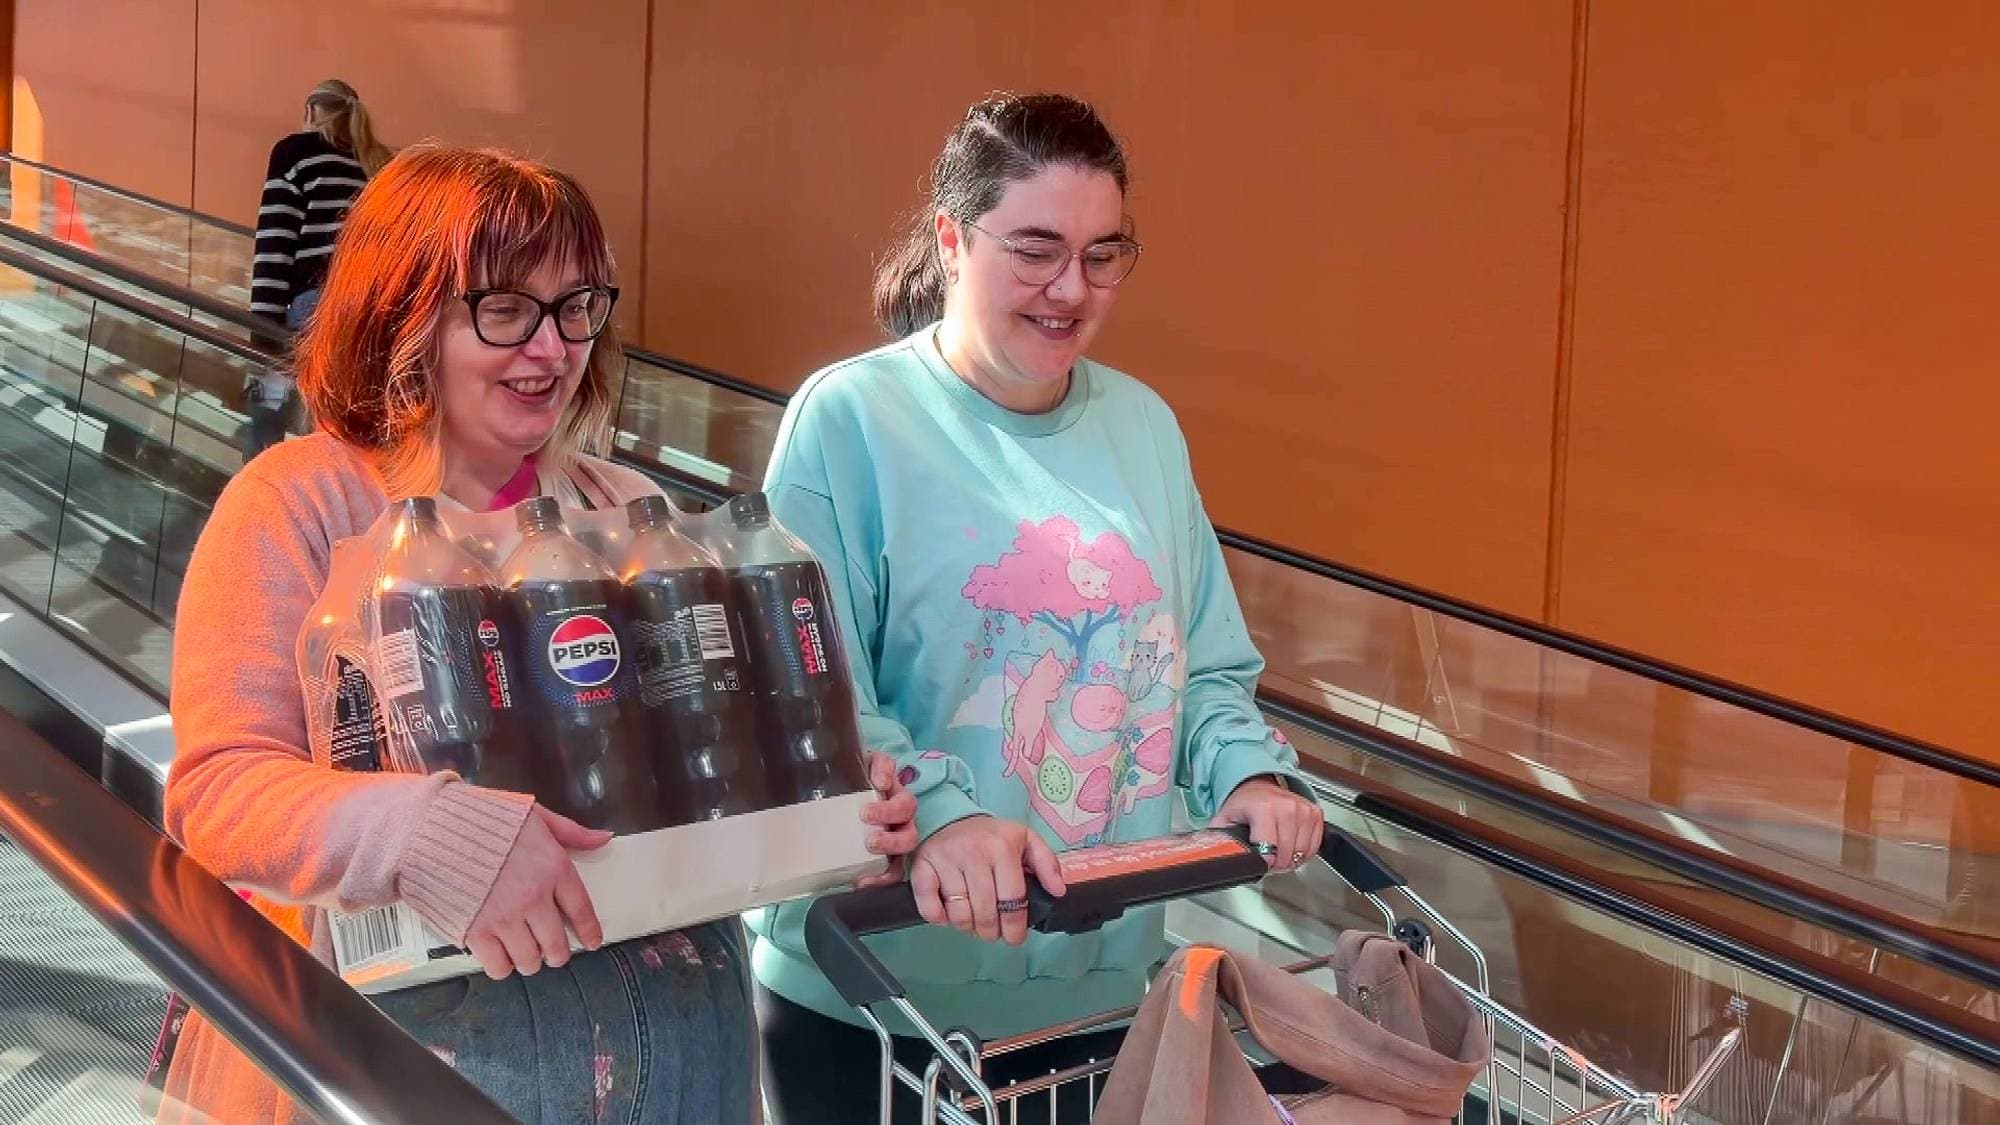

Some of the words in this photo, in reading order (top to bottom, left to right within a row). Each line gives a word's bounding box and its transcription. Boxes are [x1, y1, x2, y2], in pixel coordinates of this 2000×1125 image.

[552, 640, 617, 664] PEPSI
[796, 624, 818, 675] MAX
[482, 650, 503, 708] MAX
[572, 687, 614, 704] MAX
